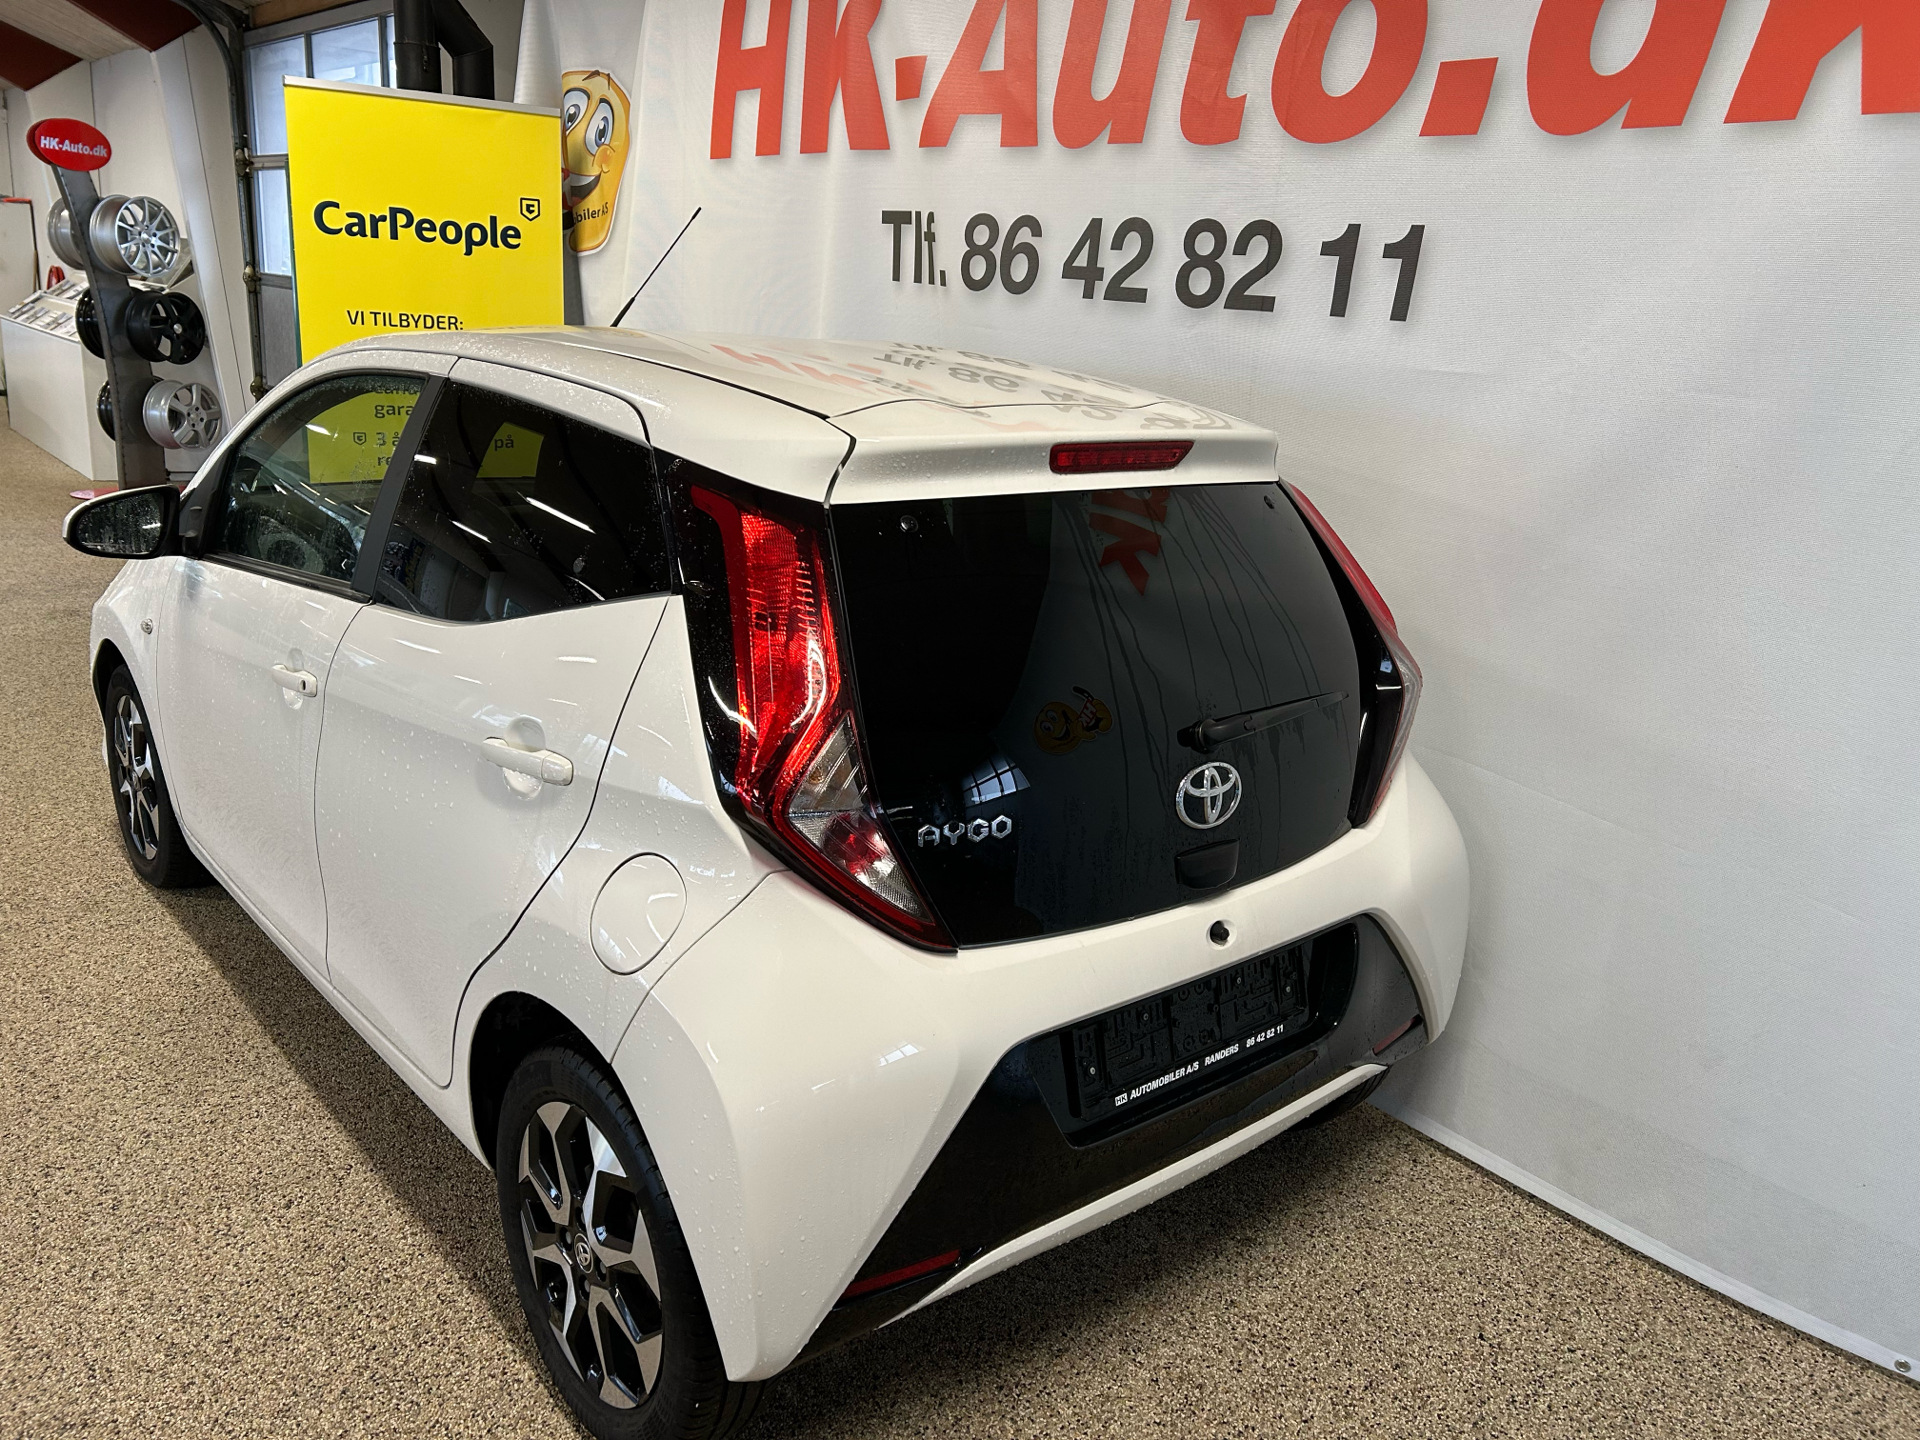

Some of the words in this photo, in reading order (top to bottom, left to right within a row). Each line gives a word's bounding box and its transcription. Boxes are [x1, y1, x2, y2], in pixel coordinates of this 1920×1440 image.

[40, 136, 107, 157] HK-Auto.dk
[313, 200, 522, 256] CarPeople
[882, 210, 946, 287] Tlf.
[961, 213, 1042, 294] 86
[1062, 217, 1154, 303] 42
[1175, 218, 1284, 312] 82
[1320, 223, 1426, 321] 11
[347, 310, 365, 325] VI
[369, 311, 464, 331] TILBYDER:
[494, 434, 515, 451] på
[918, 815, 1012, 847] AYGO
[1115, 1093, 1128, 1106] HK
[1130, 1068, 1185, 1100] AUTOMOBILER
[1186, 1061, 1199, 1075] A/S
[1204, 1044, 1239, 1066] RANDERS
[1246, 1036, 1255, 1047] 86
[1256, 1034, 1265, 1043] 42
[1266, 1030, 1275, 1039] 82
[1276, 1024, 1284, 1033] 11
